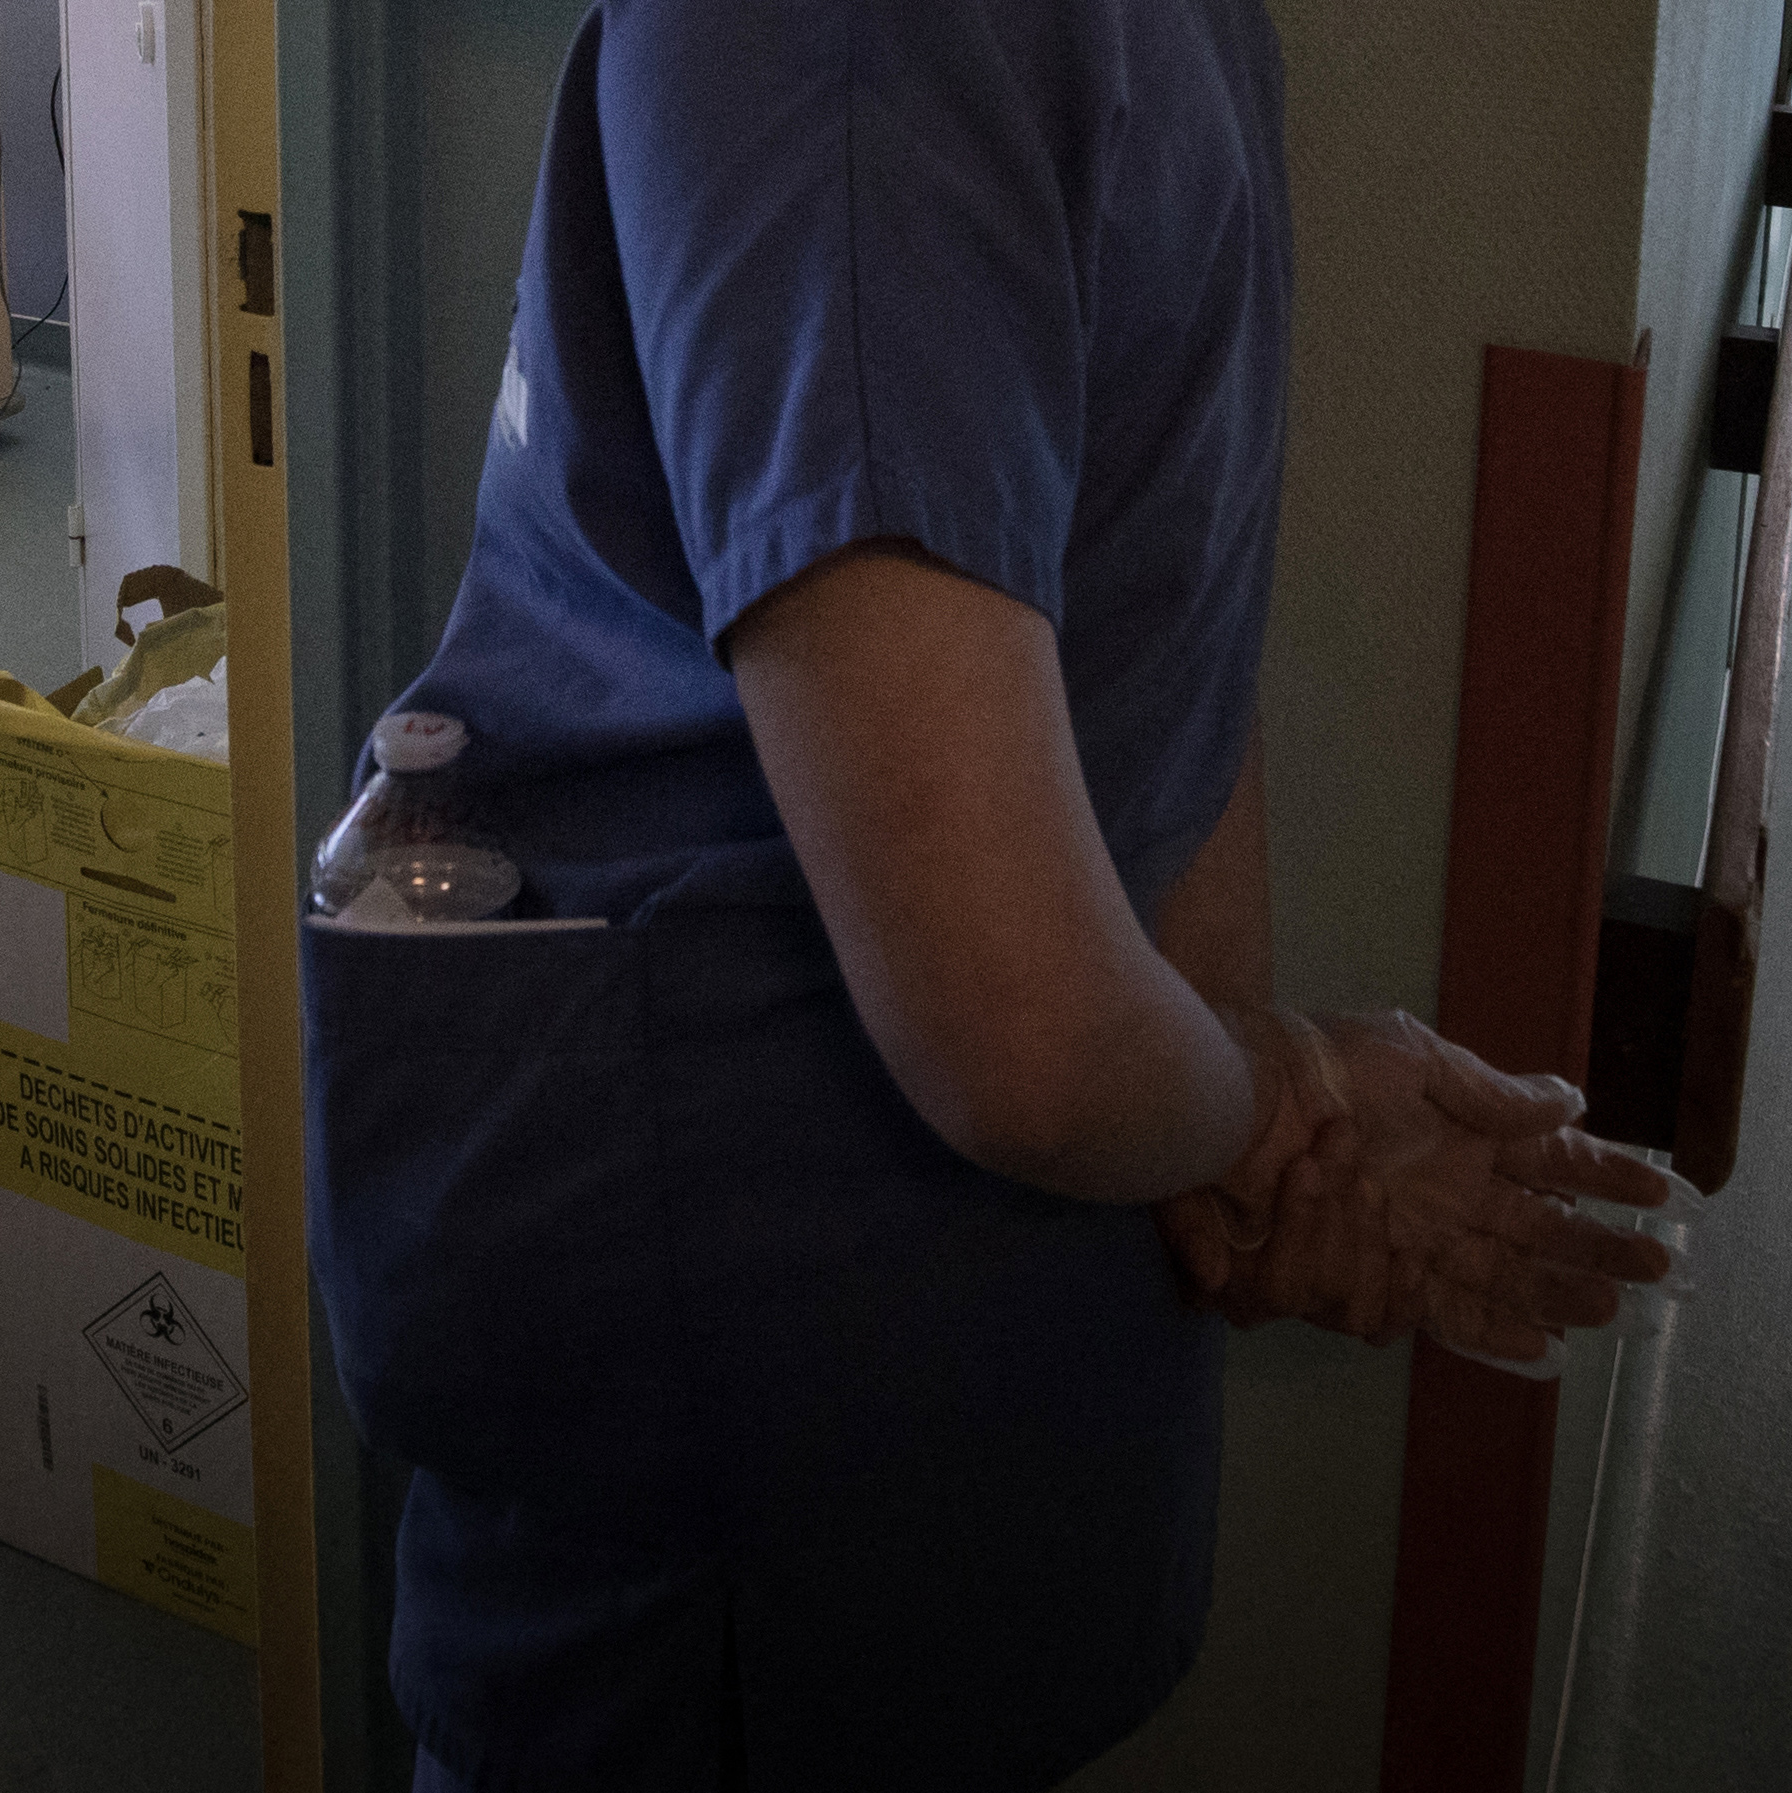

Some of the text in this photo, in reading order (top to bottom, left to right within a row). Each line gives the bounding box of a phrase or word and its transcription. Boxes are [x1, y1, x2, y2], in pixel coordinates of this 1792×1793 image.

[35, 768, 86, 791] provisoire
[82, 901, 187, 941] Fermeture définitive
[19, 1073, 117, 1132] DECHETS
[25, 1111, 88, 1158] SOINS
[94, 1136, 187, 1195] SOLIDES
[193, 1171, 221, 1205] ET
[20, 1145, 35, 1173] A
[40, 1150, 129, 1211] RISQUES
[153, 1354, 224, 1392] INFECTIEUSE
[162, 1418, 174, 1435] 6
[139, 1445, 159, 1466] UN
[170, 1458, 202, 1483] 3291
